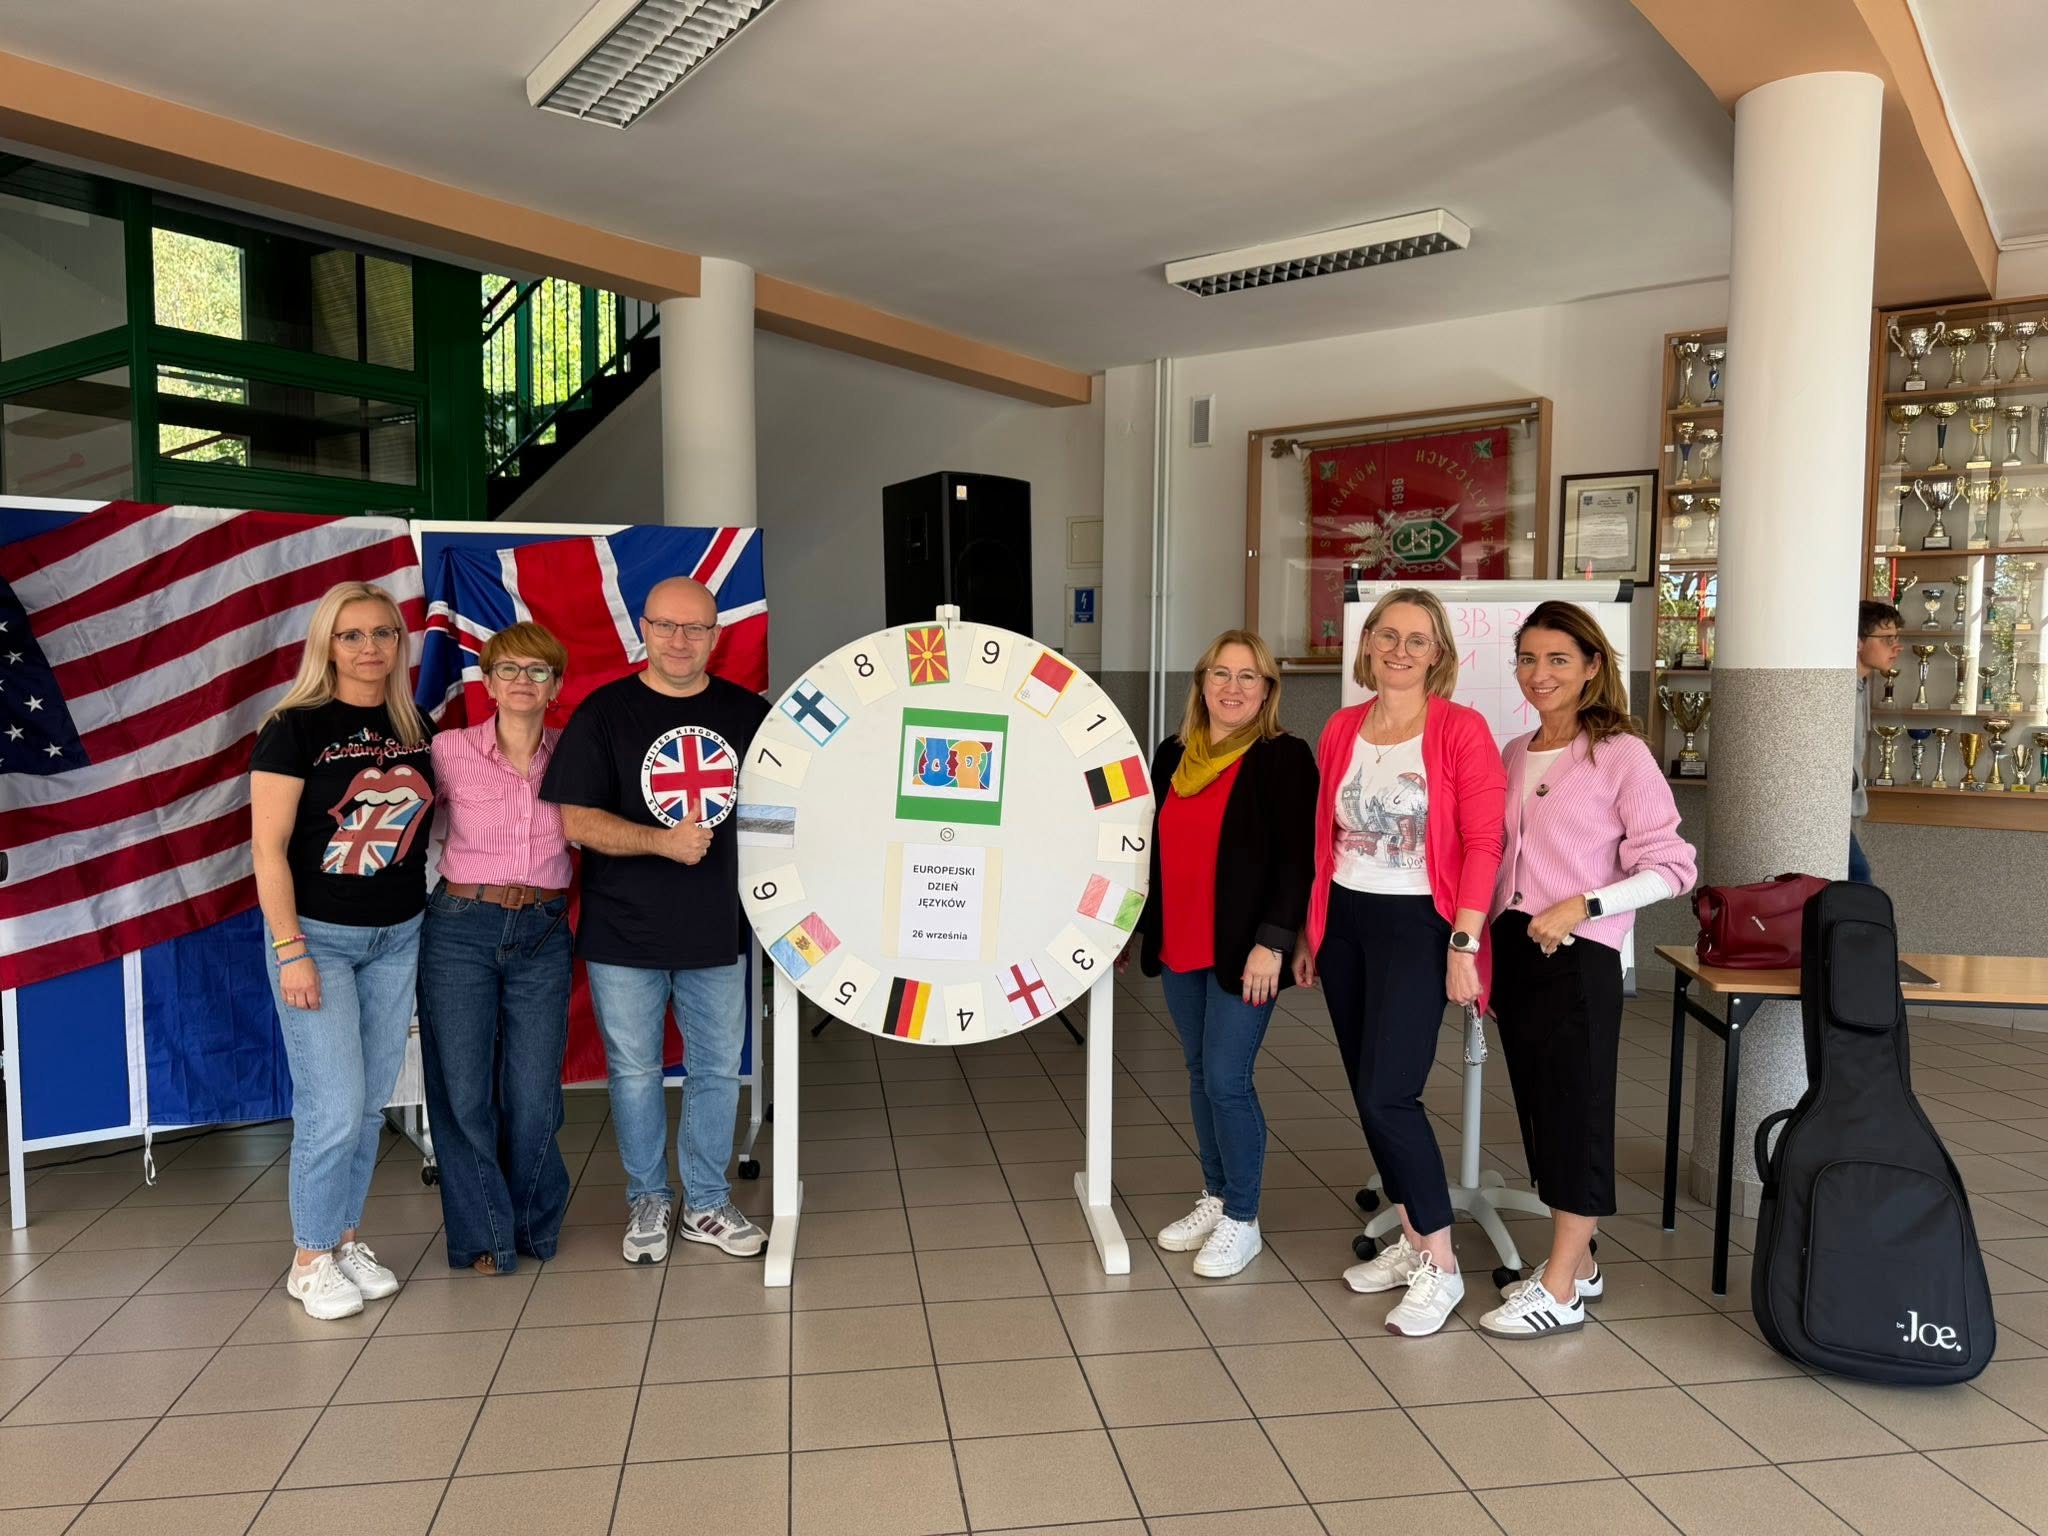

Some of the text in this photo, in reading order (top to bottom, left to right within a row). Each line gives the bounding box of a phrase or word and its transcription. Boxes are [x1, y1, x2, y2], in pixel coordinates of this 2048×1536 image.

[1455, 607, 1491, 638] 3B
[981, 640, 1000, 665] 9
[1459, 649, 1476, 671] 1
[854, 653, 875, 677] 8
[1086, 713, 1107, 732] 1
[348, 727, 383, 742] the
[644, 727, 726, 771] UNITED KINGDOM
[757, 747, 783, 768] 7
[647, 798, 703, 829] OINALS
[1121, 835, 1146, 852] 2
[913, 864, 976, 876] EUROPEJSKI
[927, 881, 959, 892] DZIEŃ
[918, 897, 967, 909] JĘZYKÓW
[912, 929, 968, 941] 26 września
[1071, 948, 1095, 971] 3
[834, 981, 857, 1006] 5
[956, 1007, 975, 1032] 4
